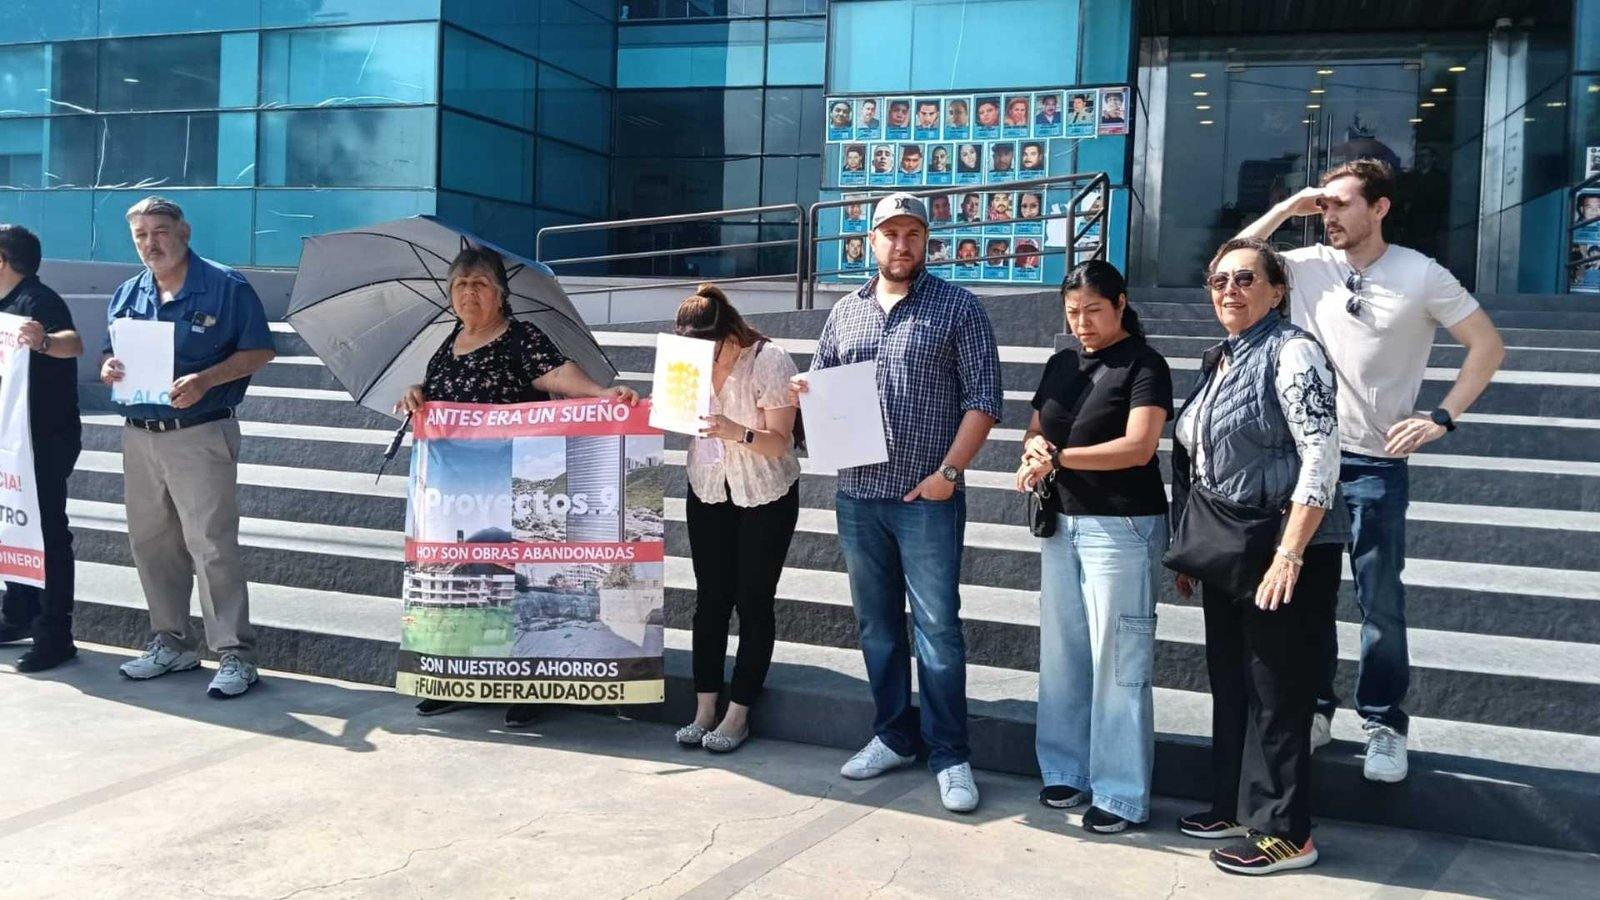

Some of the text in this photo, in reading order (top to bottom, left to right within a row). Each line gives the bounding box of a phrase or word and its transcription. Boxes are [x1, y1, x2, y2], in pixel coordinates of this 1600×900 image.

[426, 400, 630, 426] ANTES ERA UN SUEÑO
[416, 546, 635, 560] HOY SON OBRAS ABANDONADAS
[420, 656, 619, 677] SON NUESTROS AHORROS
[415, 677, 625, 700] ¡FUIMOS DEFRAUDADOS!
